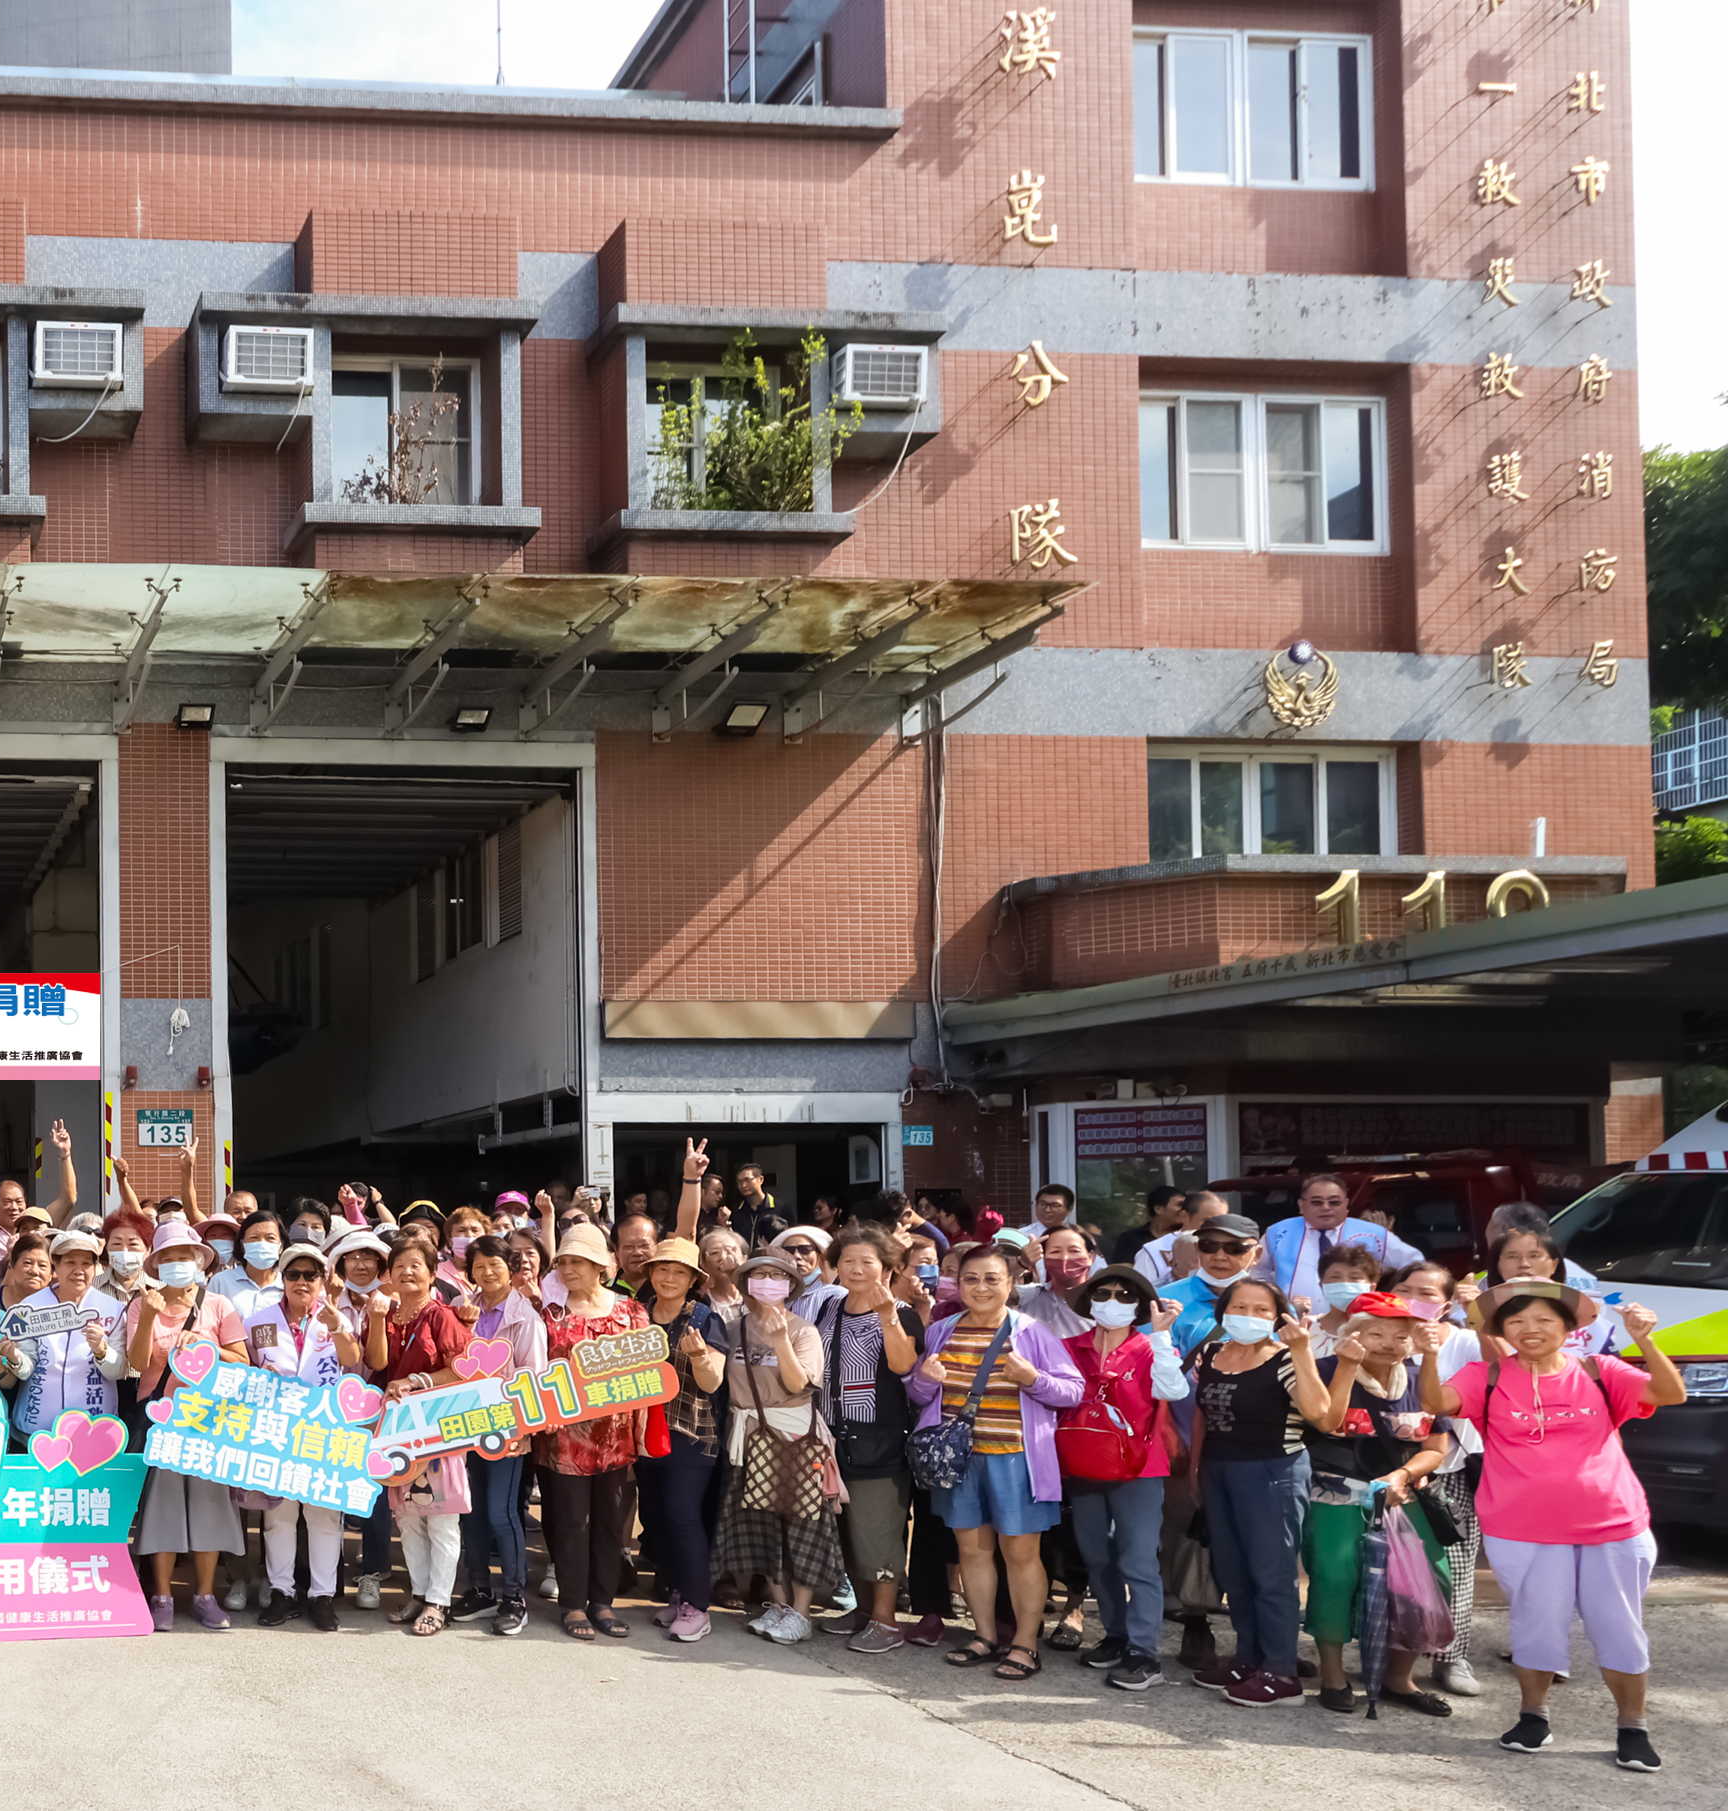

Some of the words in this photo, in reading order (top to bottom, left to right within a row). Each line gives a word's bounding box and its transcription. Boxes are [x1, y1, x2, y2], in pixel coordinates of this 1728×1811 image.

[999, 7, 1077, 570] 溪崑分隊
[1476, 0, 1533, 690] 一救災救護大隊
[1565, 0, 1618, 687] 北市政府消防局
[146, 1125, 186, 1143] 135
[912, 1132, 931, 1144] 135
[27, 1322, 57, 1335] Nature
[29, 1308, 73, 1326] 田園工房
[579, 1330, 663, 1367] 良食生活
[211, 1366, 339, 1425] 感謝客人
[173, 1391, 369, 1471] 支持與信賴
[148, 1428, 378, 1513] 讓我們回饋社會
